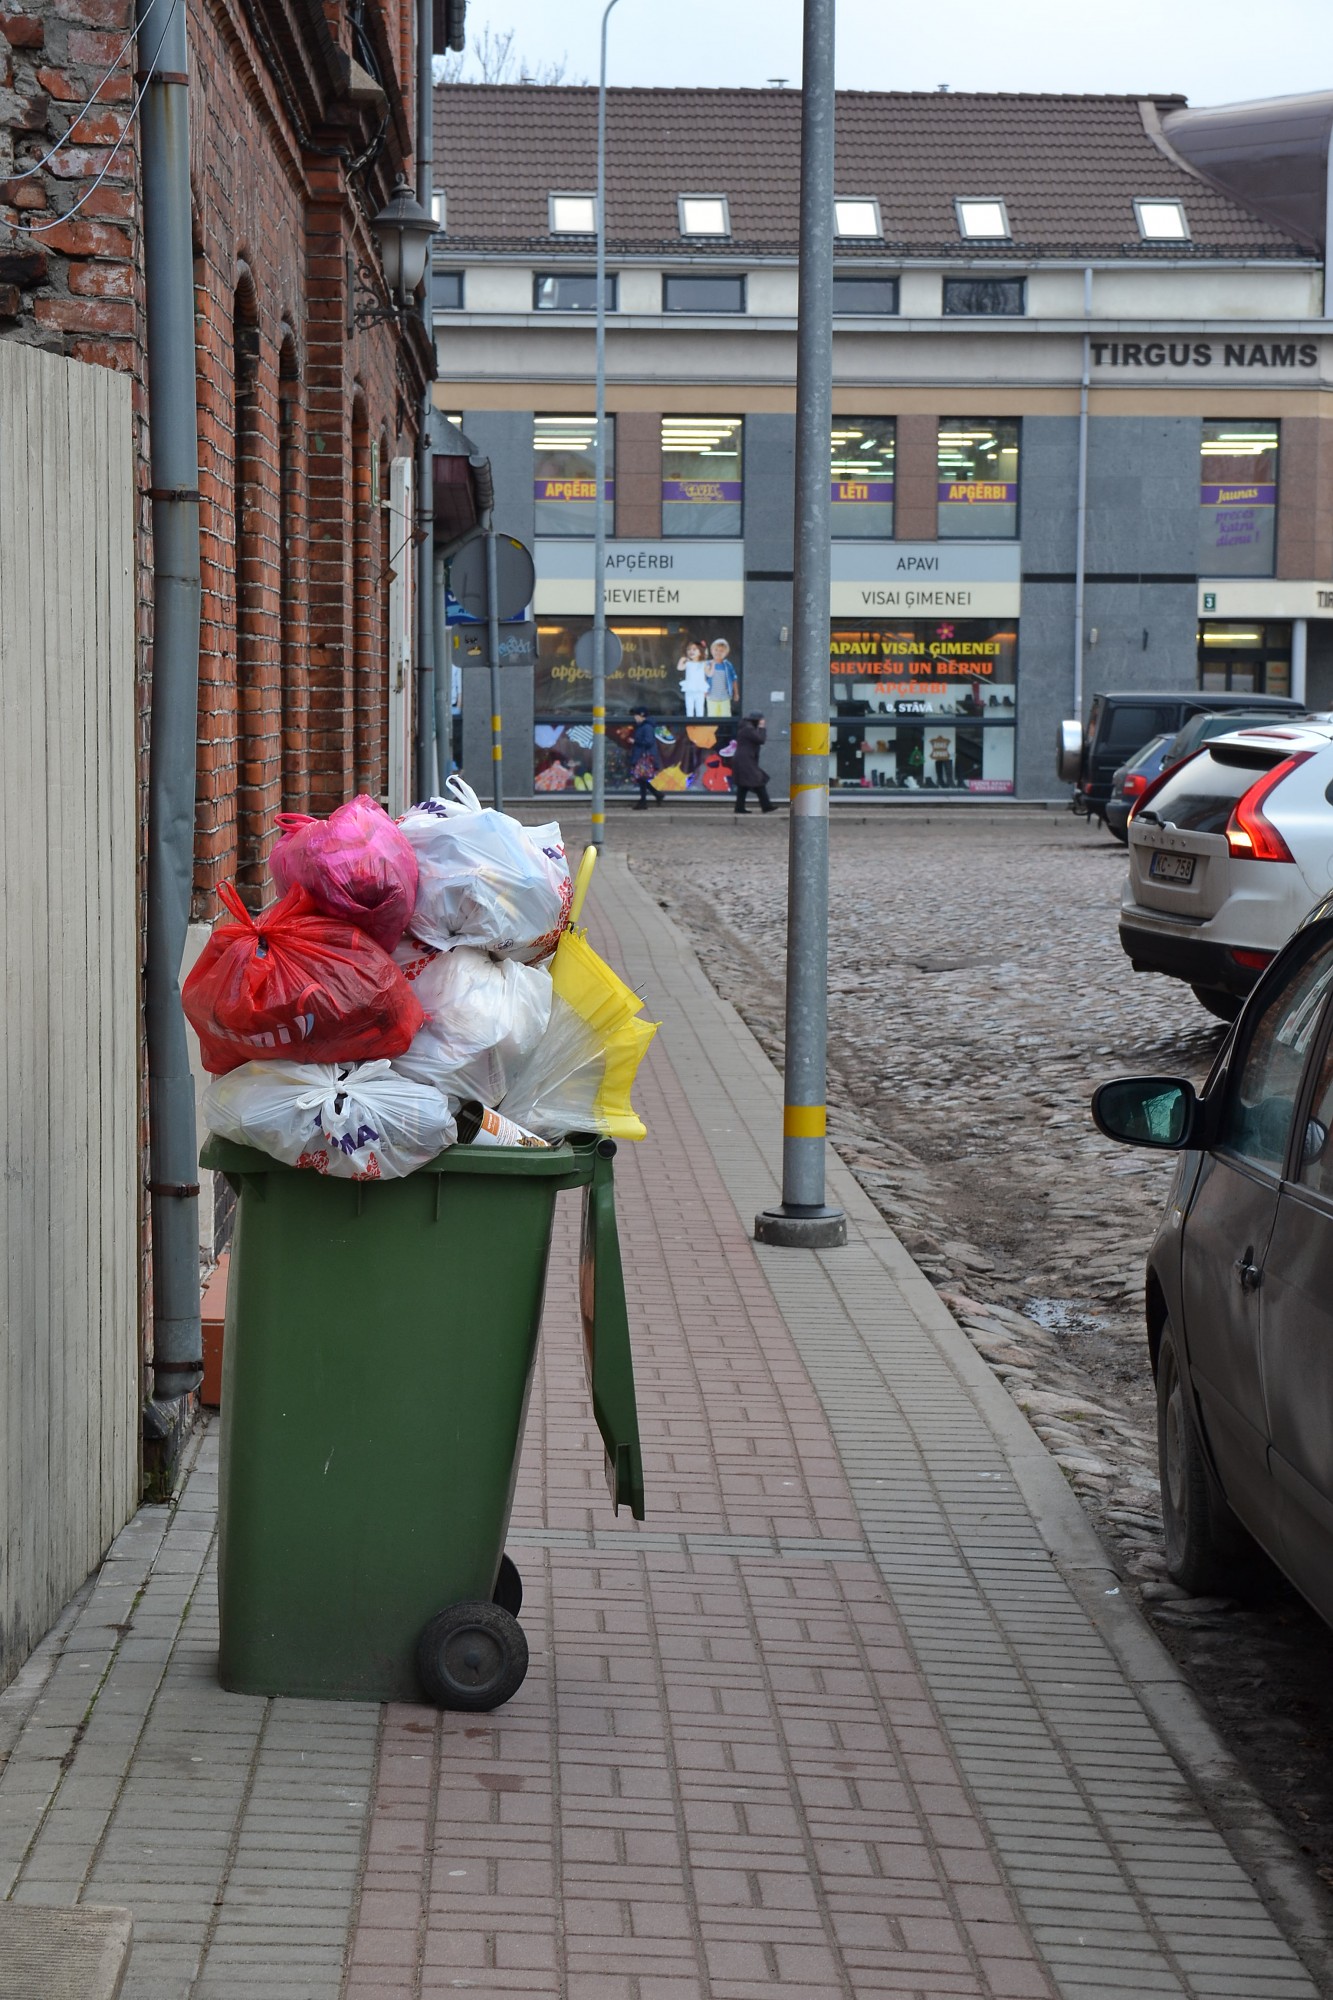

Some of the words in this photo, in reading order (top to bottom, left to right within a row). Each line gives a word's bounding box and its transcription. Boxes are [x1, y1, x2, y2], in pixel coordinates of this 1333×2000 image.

[1090, 343, 1212, 367] TIRGUS
[1224, 343, 1318, 367] NAMS
[545, 480, 597, 502] APĢĒRB
[840, 480, 868, 499] LĒTI
[949, 481, 1007, 504] APĢĒRBI
[605, 552, 674, 572] APĢĒRBI
[896, 557, 939, 571] APAVI
[862, 591, 900, 605] VISAI
[905, 591, 971, 608] ĢIMENEI
[830, 642, 877, 655] APAVI
[881, 642, 925, 655] VISAI
[929, 642, 1000, 659] ĢIMENEI
[830, 659, 903, 675] SIEVIEŠU
[908, 662, 932, 675] UN
[936, 660, 993, 675] BĒRNU
[874, 680, 947, 697] APĢĒRBI
